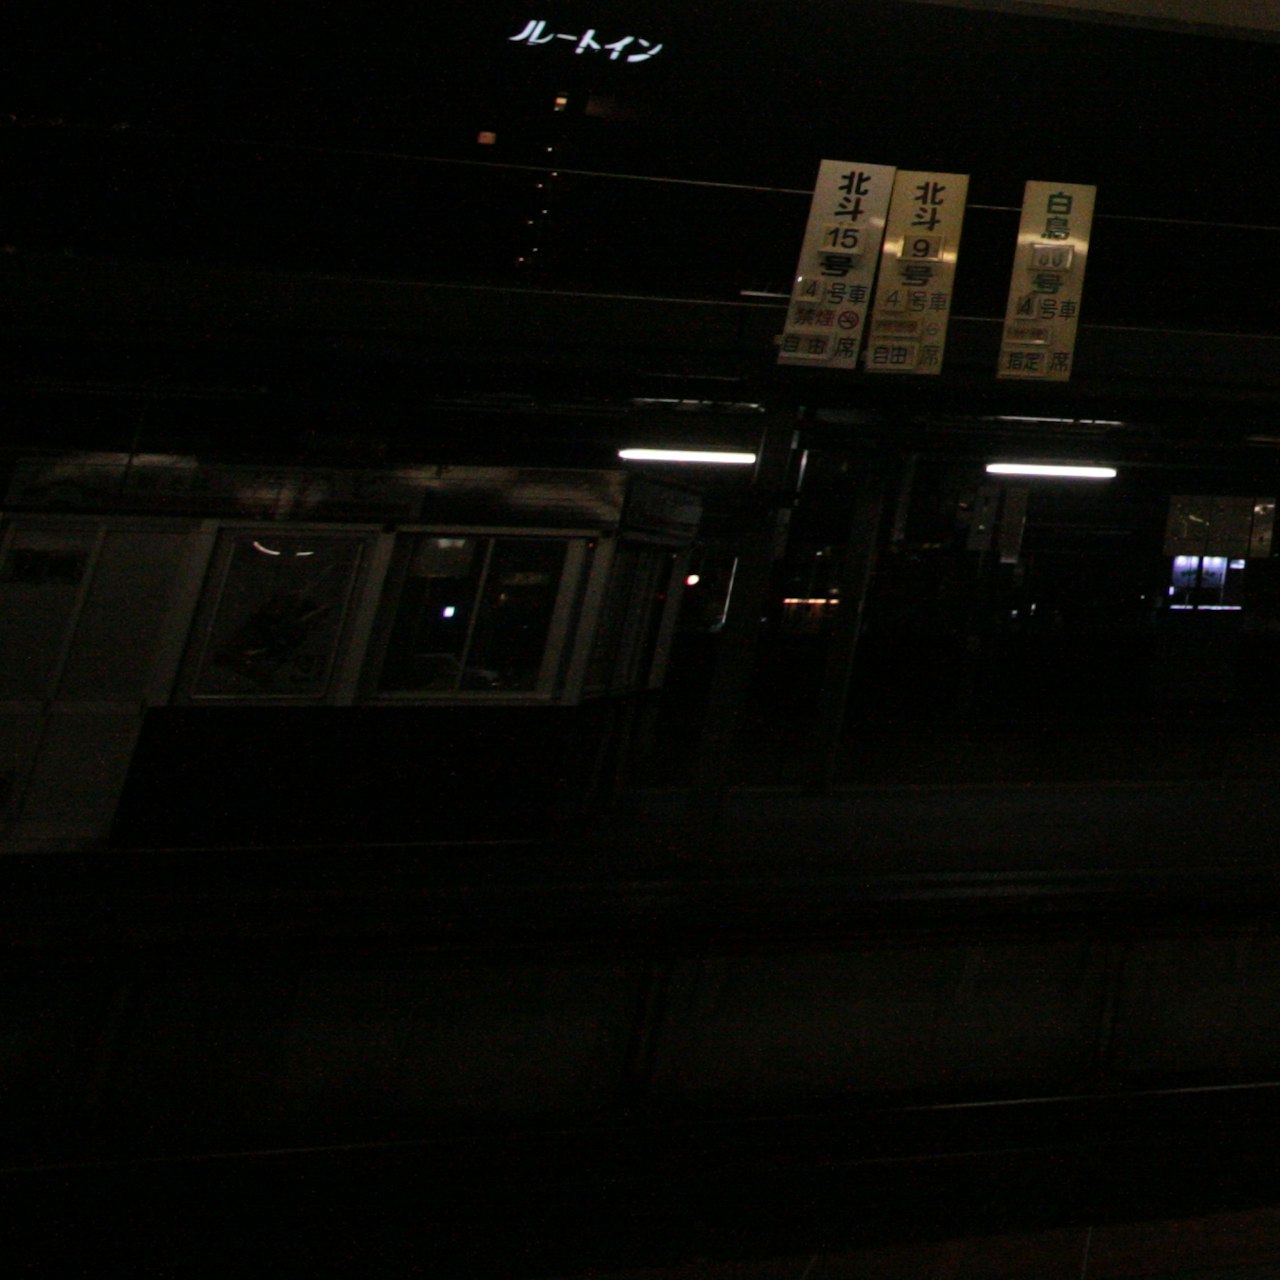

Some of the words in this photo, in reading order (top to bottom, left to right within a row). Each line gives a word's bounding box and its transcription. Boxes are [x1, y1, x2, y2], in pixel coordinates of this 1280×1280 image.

[509, 20, 663, 63] ルートイン
[828, 227, 859, 249] 15
